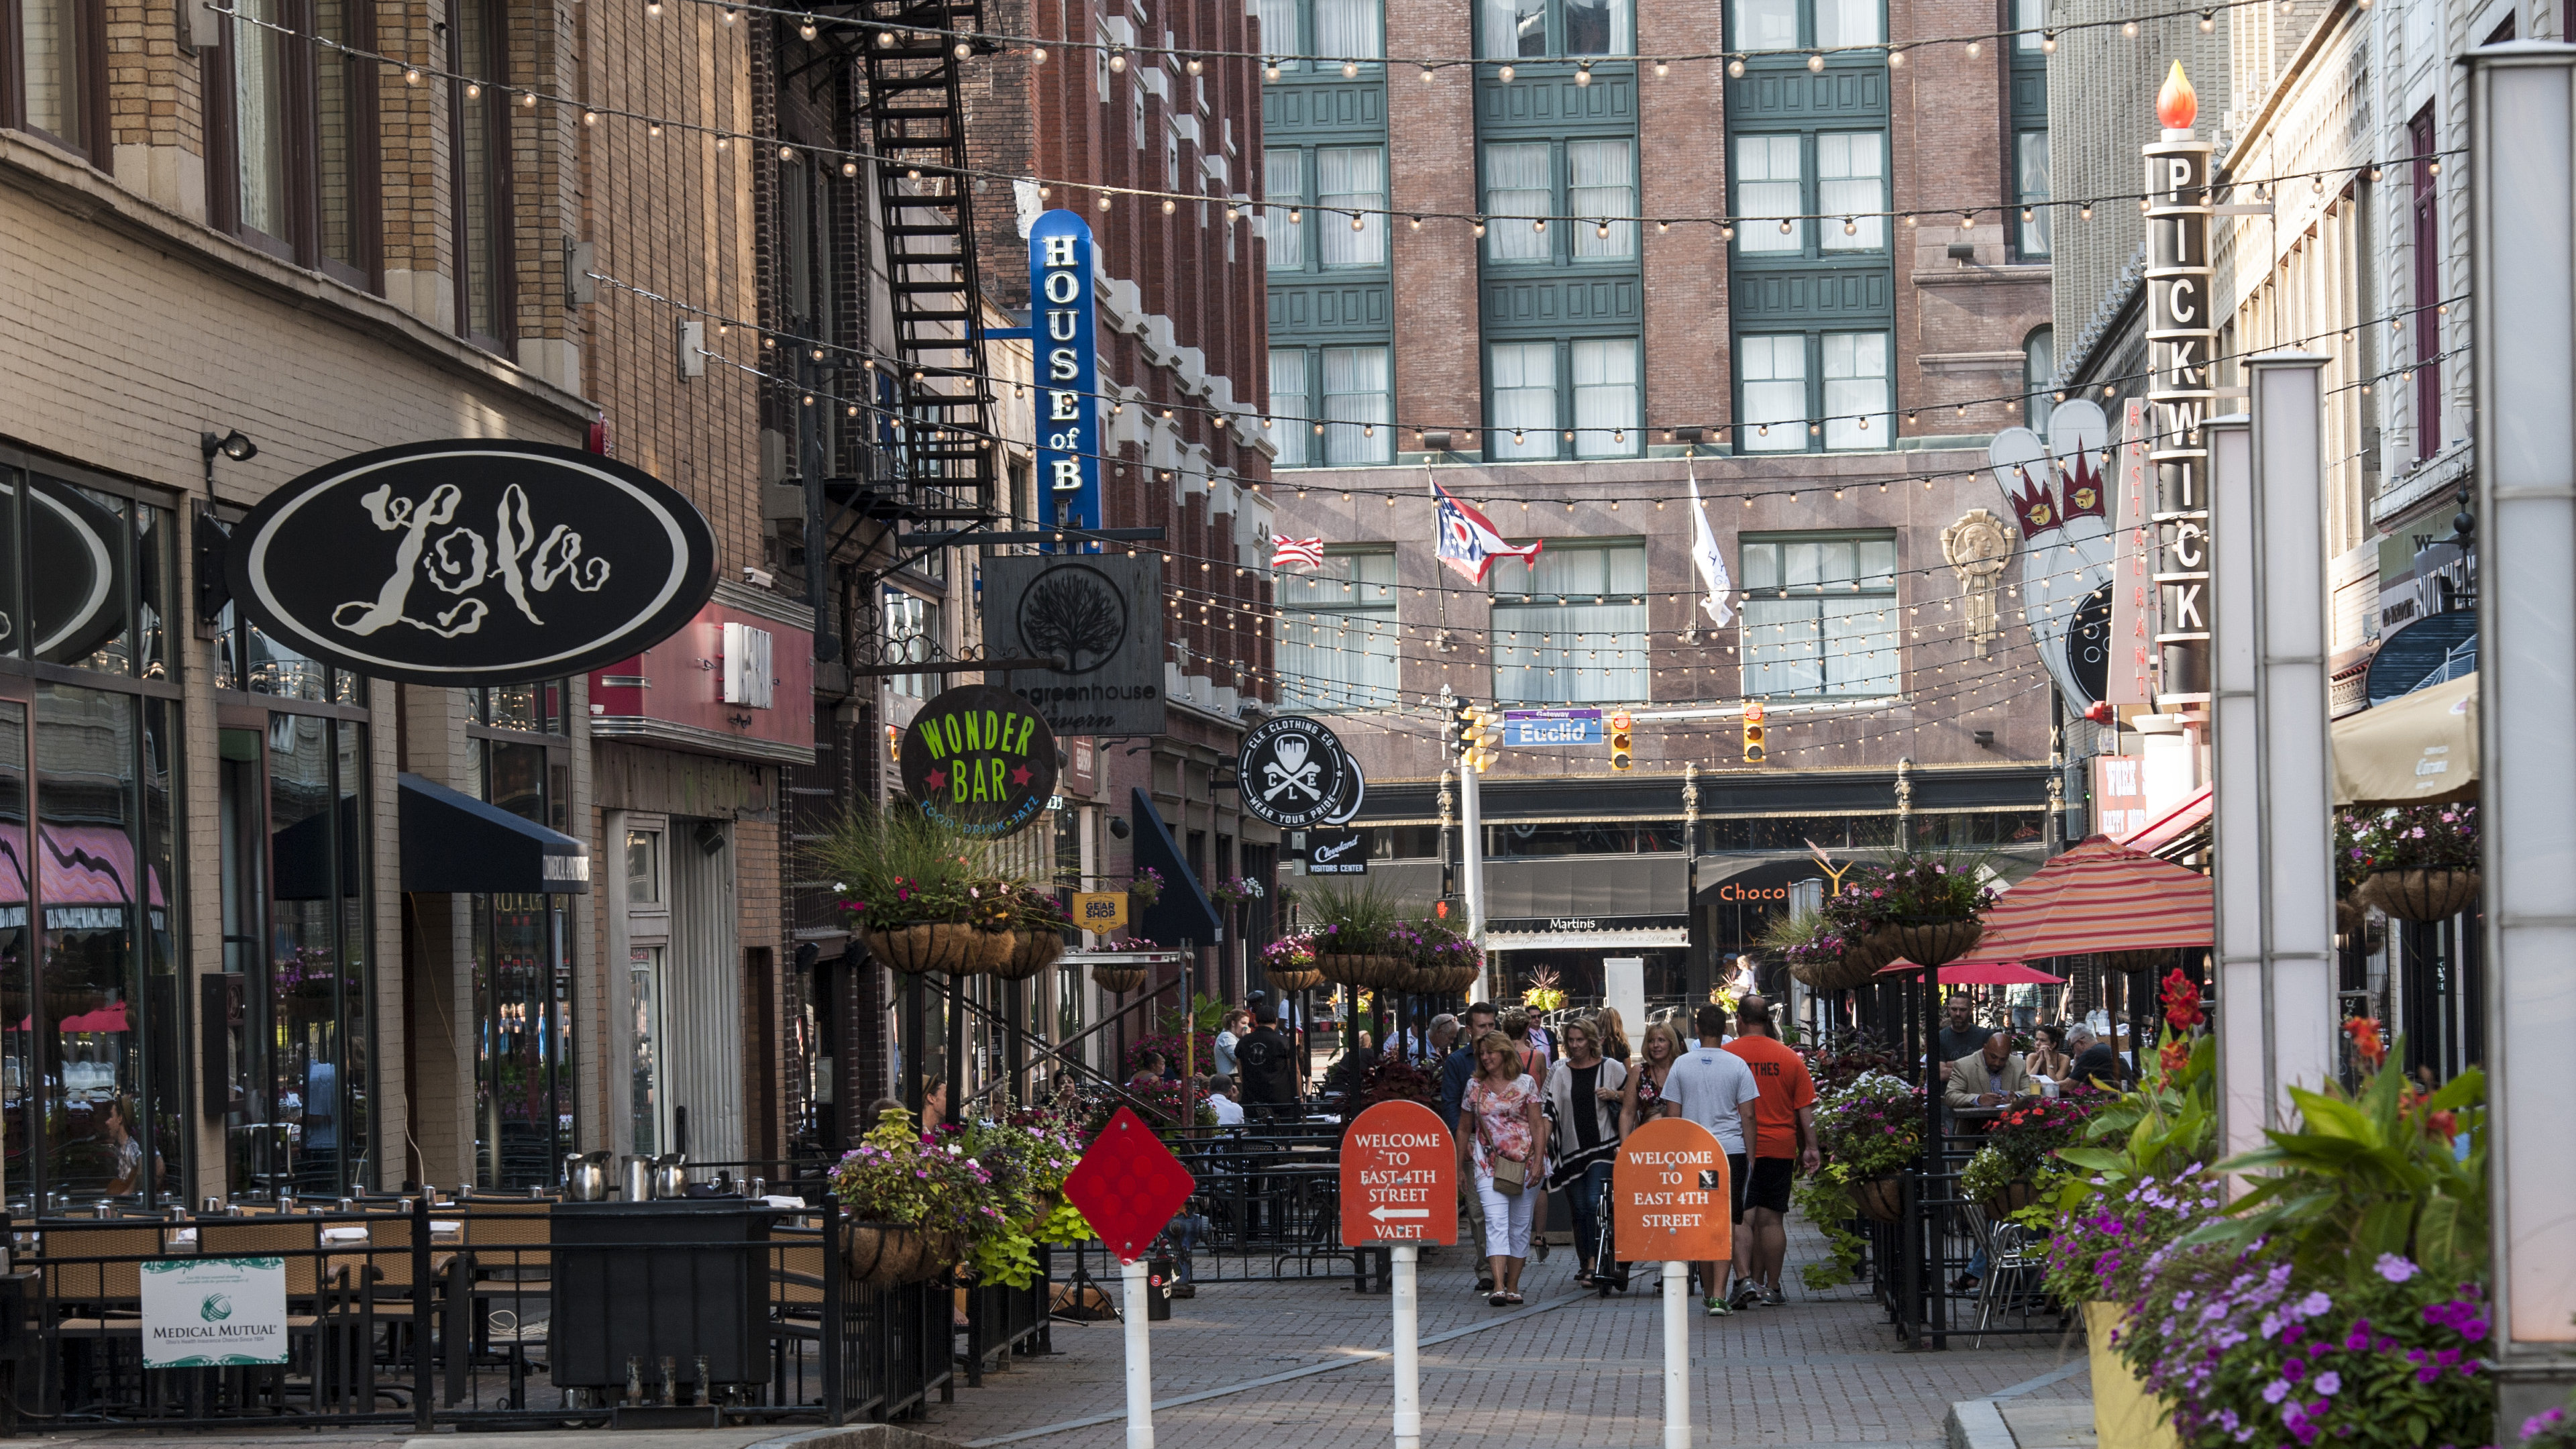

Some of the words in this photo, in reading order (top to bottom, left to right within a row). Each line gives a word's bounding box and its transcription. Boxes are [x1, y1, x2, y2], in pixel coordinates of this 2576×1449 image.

[1042, 235, 1080, 421] HOUSE
[2167, 158, 2203, 628] PICKWICK
[1049, 427, 1081, 450] of
[2129, 405, 2147, 696] RESTAURANT
[331, 483, 610, 638] Lola
[1042, 708, 1116, 729] avern
[1536, 710, 1570, 718] Gateway
[918, 710, 1035, 760] WONDER
[1248, 731, 1266, 749] CLE
[1269, 720, 1319, 735] CLOTHING
[1321, 733, 1334, 750] CO.
[1519, 722, 1586, 743] Euclid
[952, 758, 1007, 804] BAR
[920, 800, 955, 828] FOOD
[963, 820, 1006, 835] DRINK
[1011, 795, 1040, 824] JAZZ
[1249, 796, 1274, 819] WEAR
[1279, 814, 1305, 824] YOUR
[1309, 794, 1336, 819] PRIDE
[1314, 834, 1358, 863] Cleveland
[1340, 864, 1364, 872] CENTER
[1720, 881, 1825, 901] Chocol
[1085, 902, 1116, 910] GEAR
[1085, 910, 1116, 918] SHOP
[1550, 917, 1596, 930] Martinis
[1354, 1134, 1440, 1148] WELCOME
[1385, 1152, 1410, 1166] TO
[1629, 1151, 1713, 1165] WELCOME
[1360, 1170, 1399, 1184] EAST
[1403, 1170, 1437, 1184] 4TH
[1658, 1171, 1683, 1185] TO
[1369, 1189, 1429, 1203] STREET
[1633, 1192, 1674, 1205] EAST
[1676, 1191, 1709, 1205] 4TH
[1642, 1214, 1702, 1228] STREET
[1373, 1225, 1424, 1238] VALET
[154, 1326, 215, 1339] MEDICAL
[219, 1324, 275, 1336] MUTUAL
